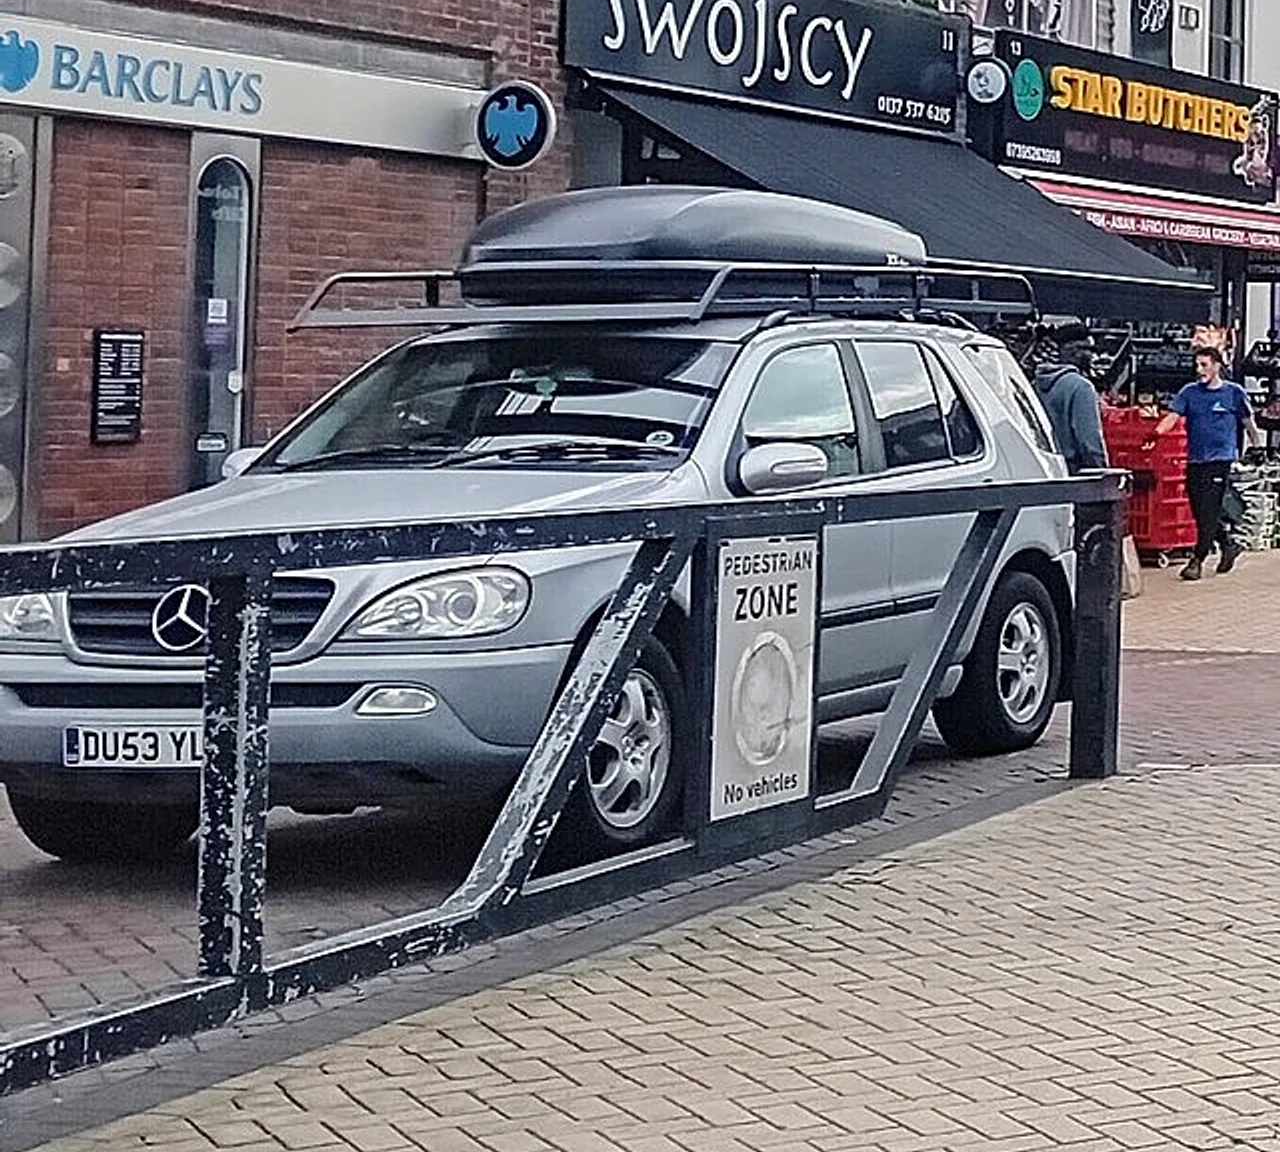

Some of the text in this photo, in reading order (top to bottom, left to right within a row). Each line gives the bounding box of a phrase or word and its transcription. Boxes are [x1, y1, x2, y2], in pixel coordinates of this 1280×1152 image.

[941, 29, 955, 52] 11
[1010, 40, 1022, 56] 13
[49, 44, 264, 115] BARCLAYS
[1050, 65, 1251, 144] STAR BUTCHERS
[724, 551, 812, 576] PEDESTRIAN
[735, 583, 798, 621] ZONE
[82, 731, 204, 761] DU53 YL
[724, 773, 798, 804] No vehicles
